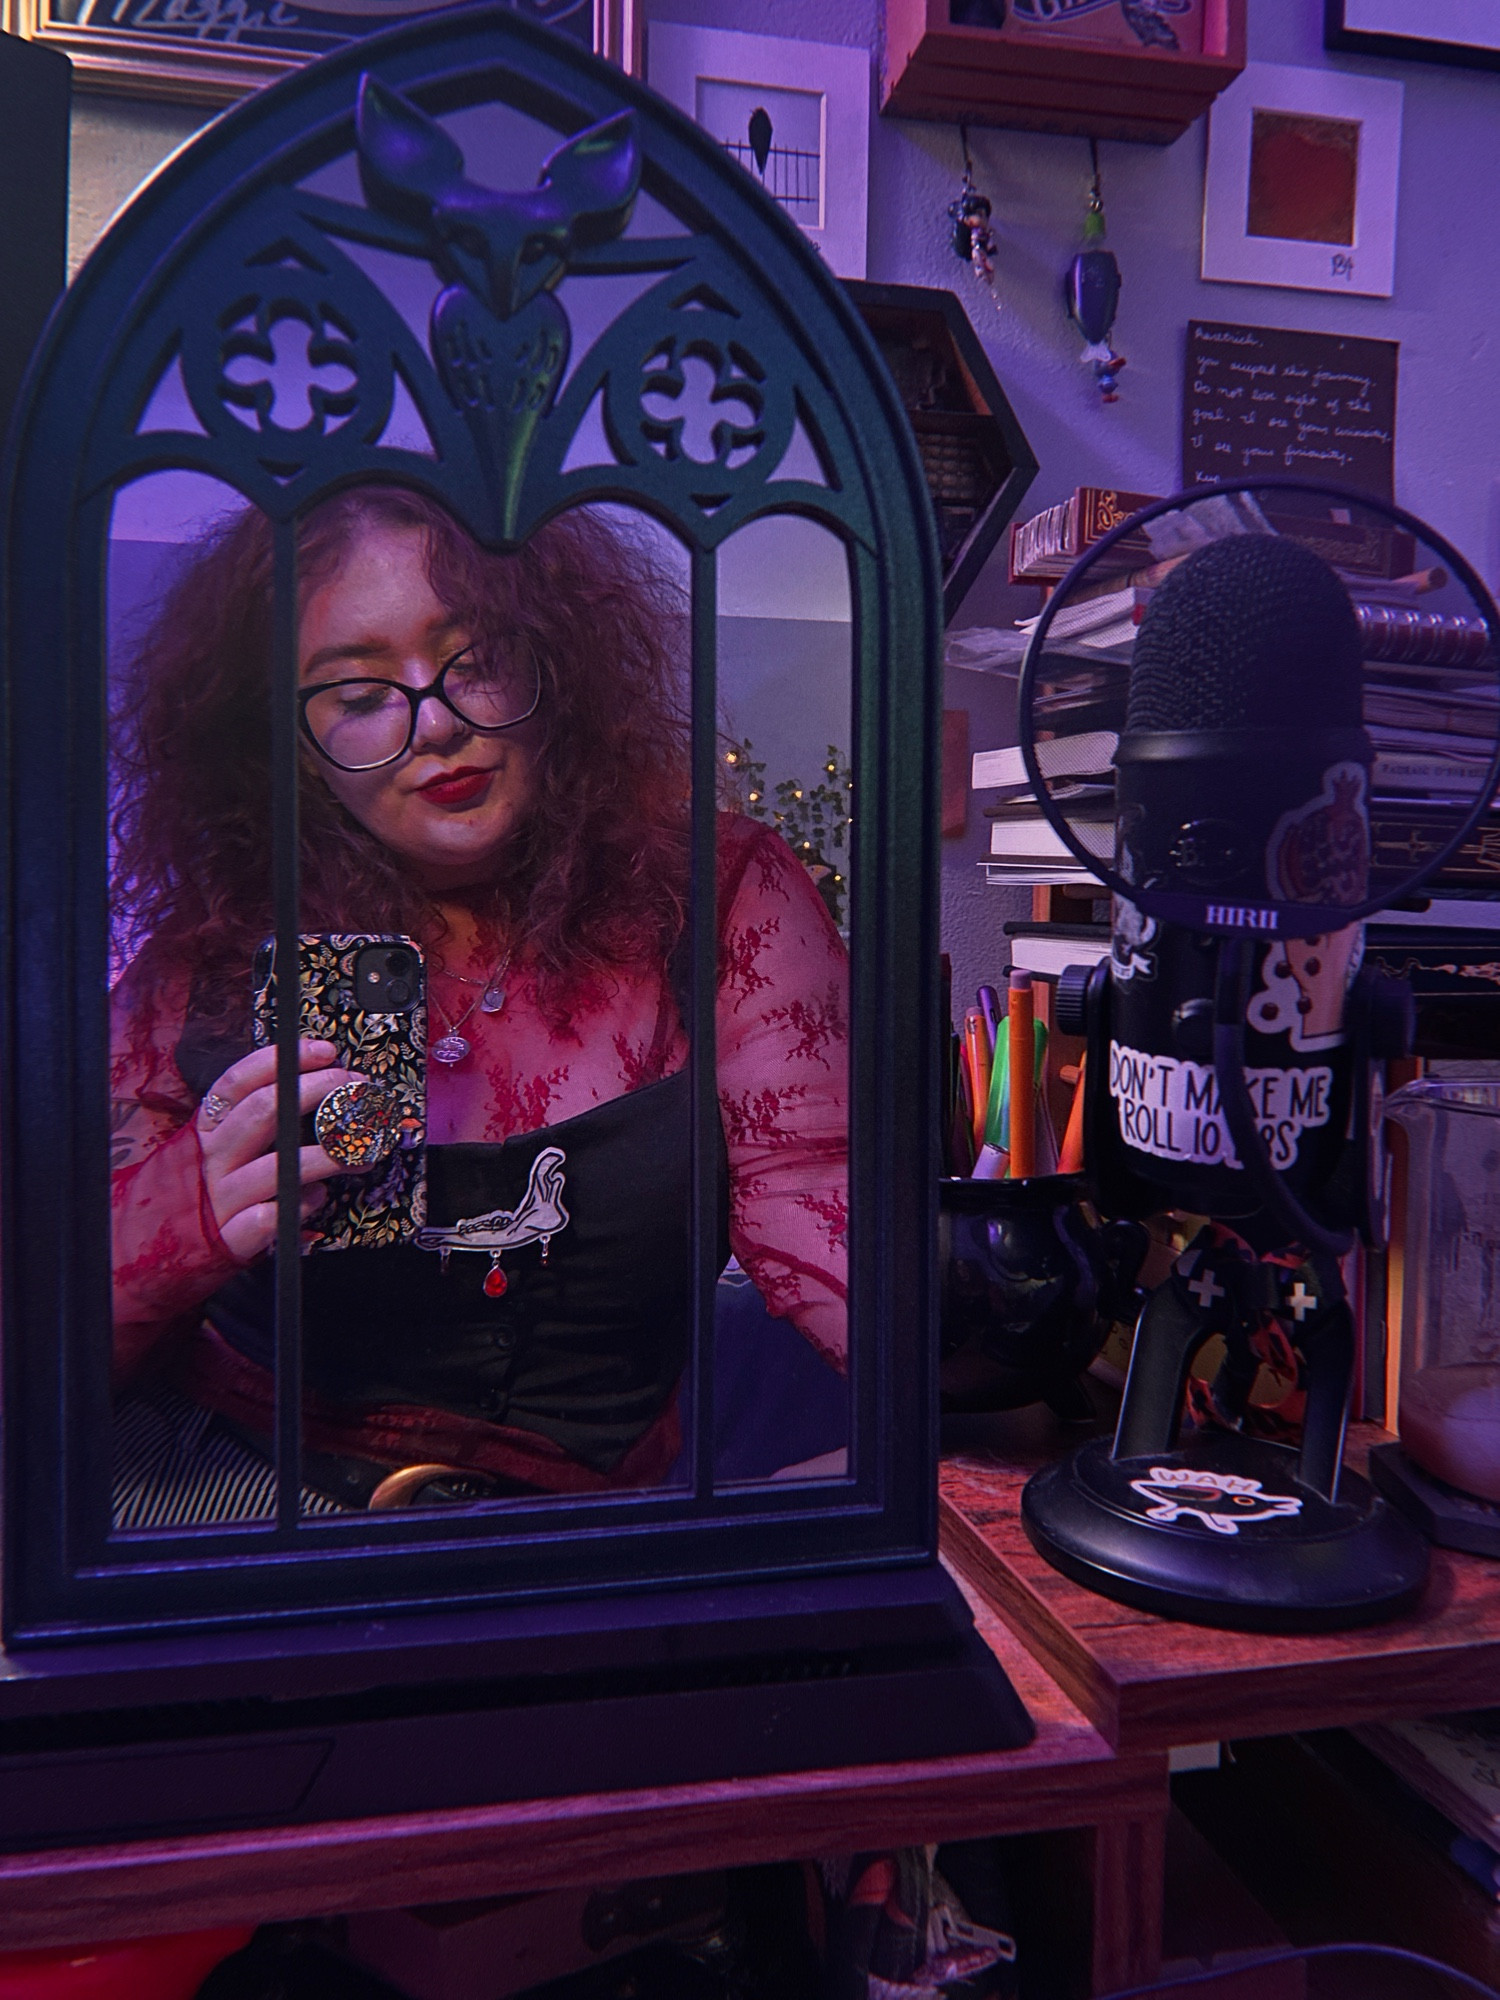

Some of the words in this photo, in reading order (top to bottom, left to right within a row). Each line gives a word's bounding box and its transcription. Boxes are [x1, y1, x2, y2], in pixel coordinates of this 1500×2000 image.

[1185, 1070, 1280, 1119] MKE
[1290, 1075, 1328, 1119] ME
[1123, 1097, 1181, 1152] ROLL
[1158, 1471, 1254, 1491] WAH
